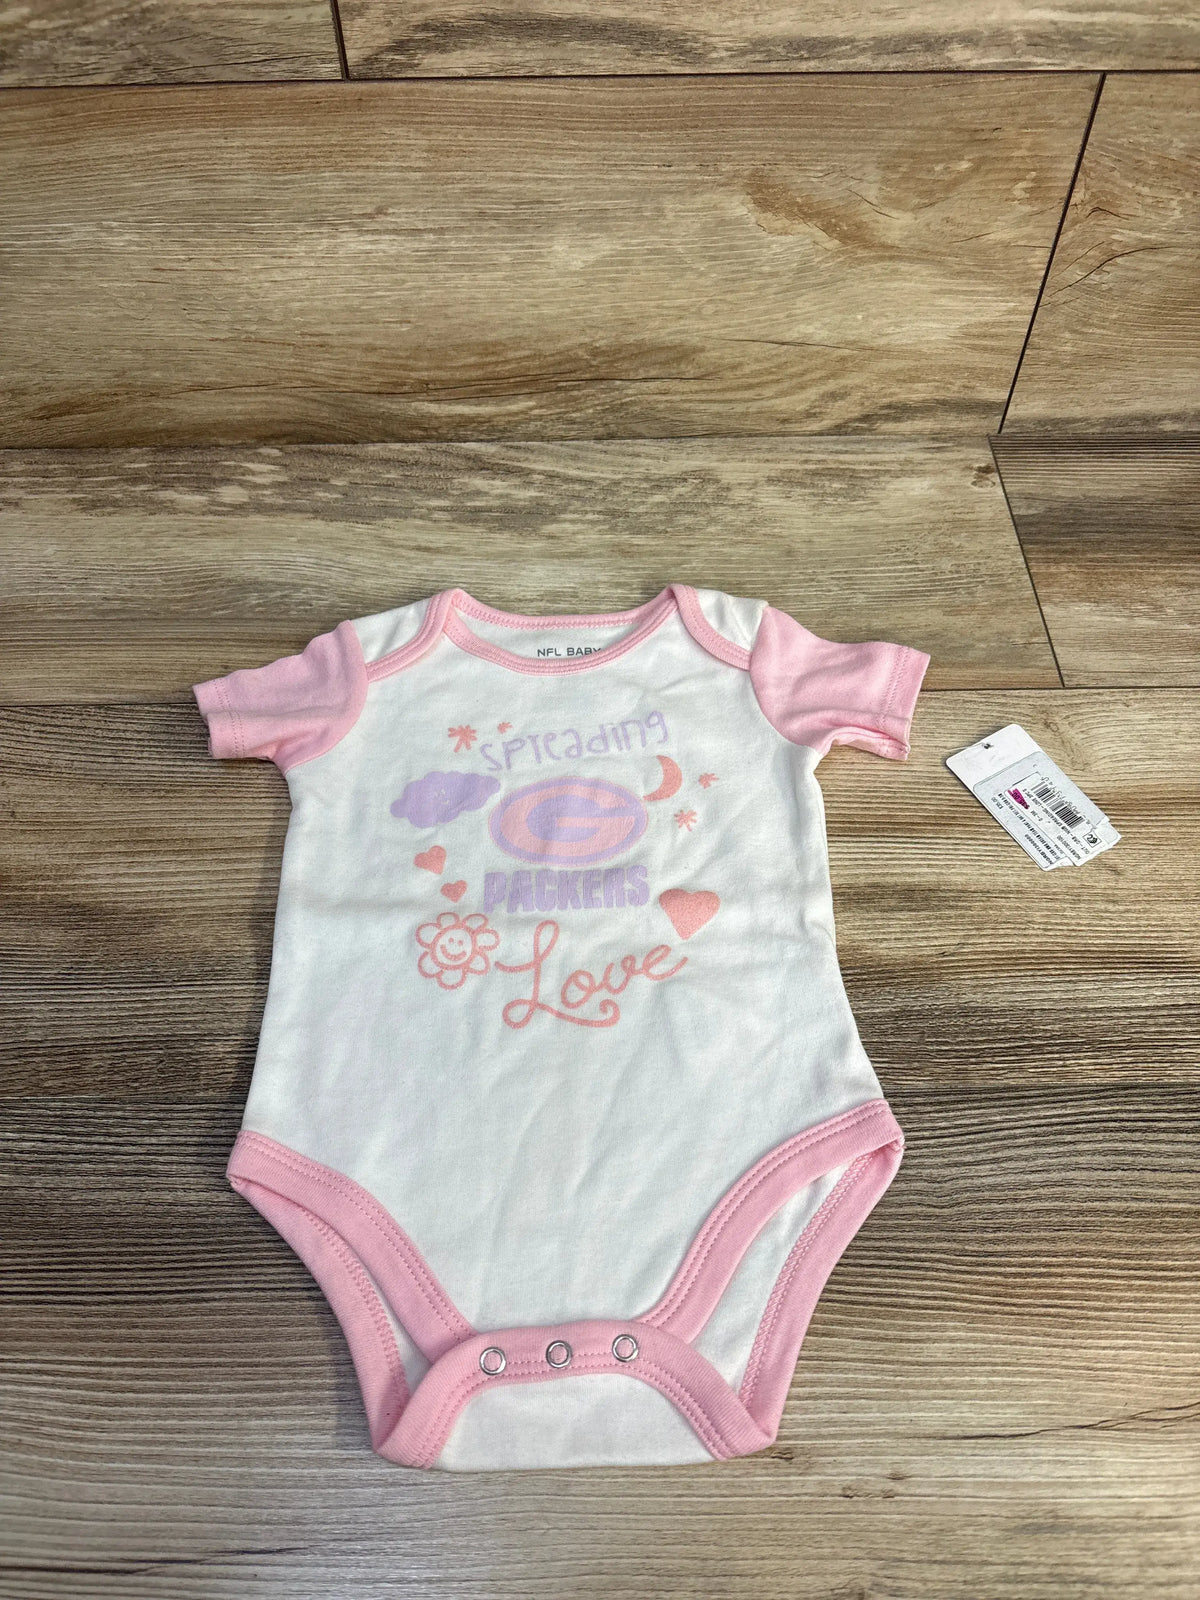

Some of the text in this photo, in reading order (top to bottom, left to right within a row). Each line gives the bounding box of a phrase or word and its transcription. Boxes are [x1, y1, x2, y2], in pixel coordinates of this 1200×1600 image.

[537, 648, 561, 657] NFL
[483, 865, 650, 913] PACKERS
[494, 920, 688, 1028] Love
